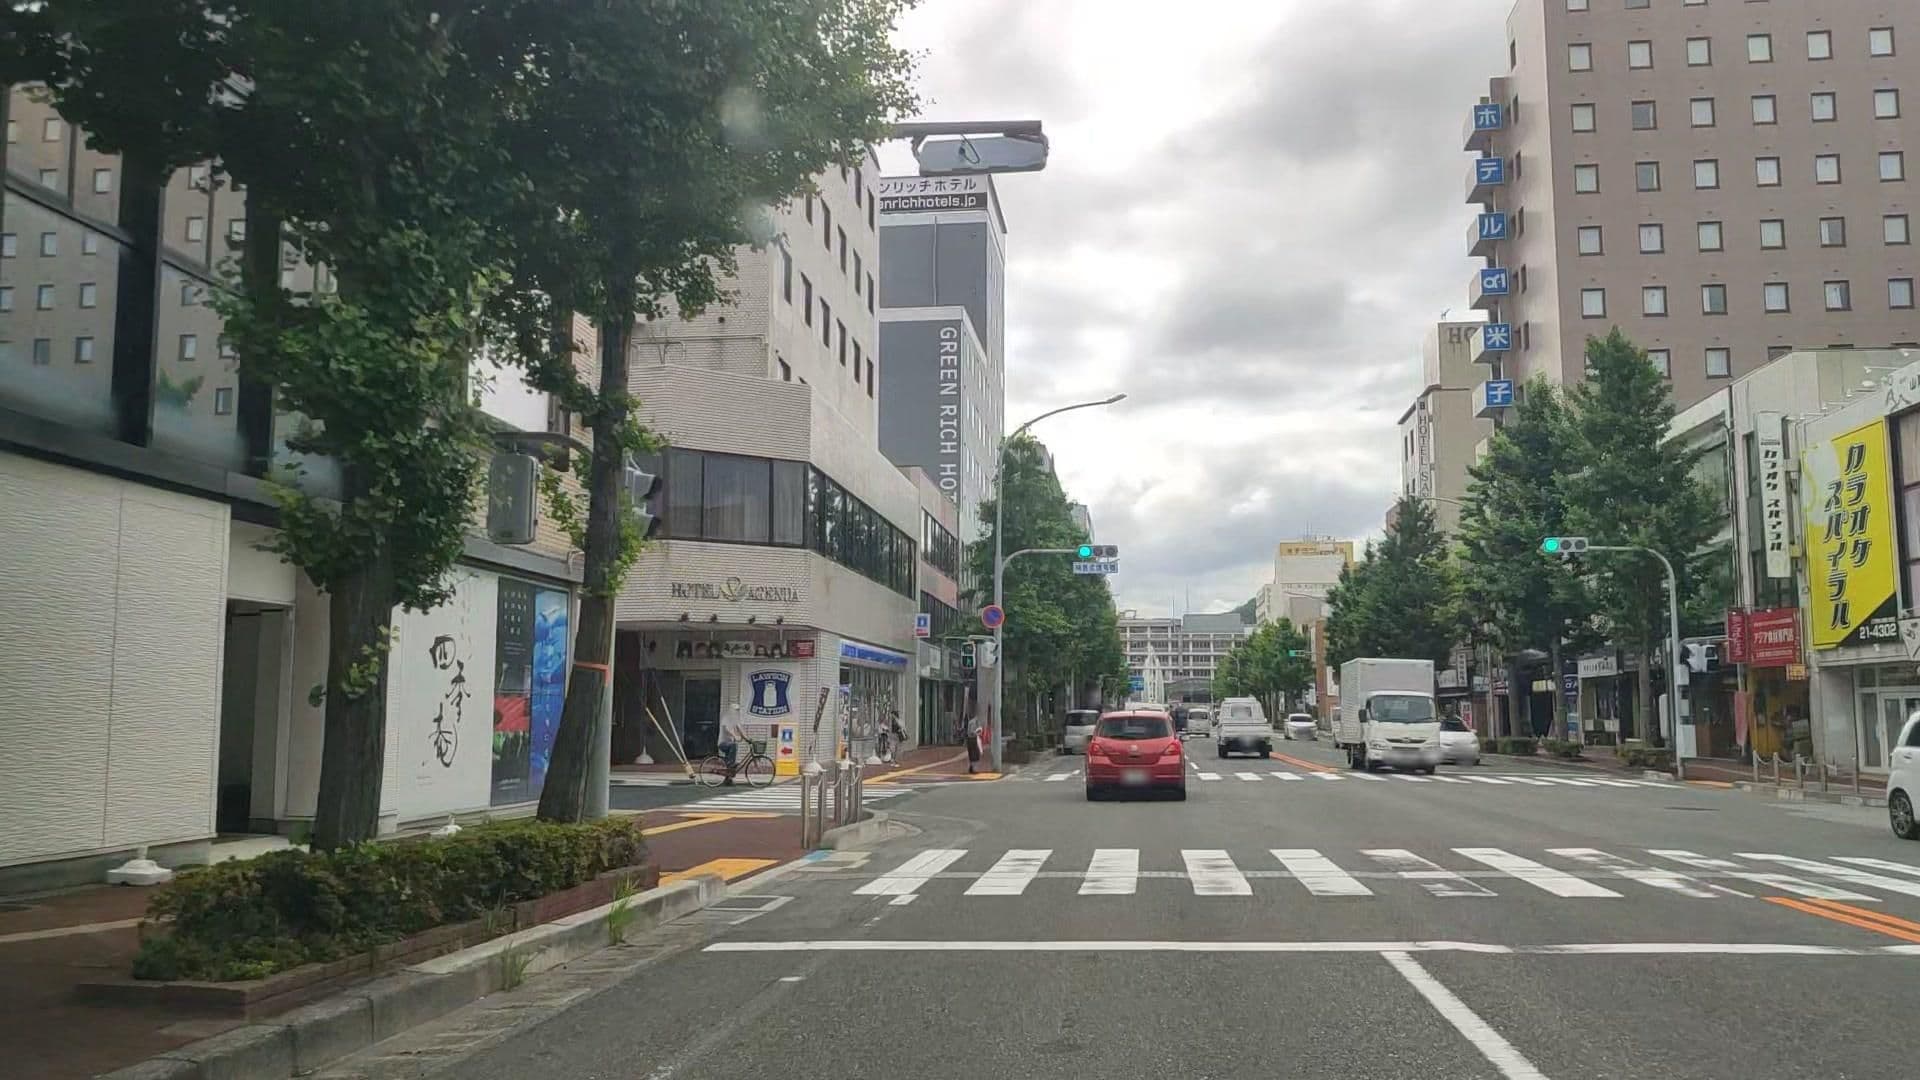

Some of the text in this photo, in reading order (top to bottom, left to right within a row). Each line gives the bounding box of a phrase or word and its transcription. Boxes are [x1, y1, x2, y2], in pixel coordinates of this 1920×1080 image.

[939, 327, 957, 395] GREEN
[939, 405, 957, 453] RICH
[1419, 415, 1429, 466] HOTEL
[1844, 442, 1872, 567] カラオケ
[1824, 479, 1849, 630] スパイラル
[1859, 622, 1898, 639] 21-4302
